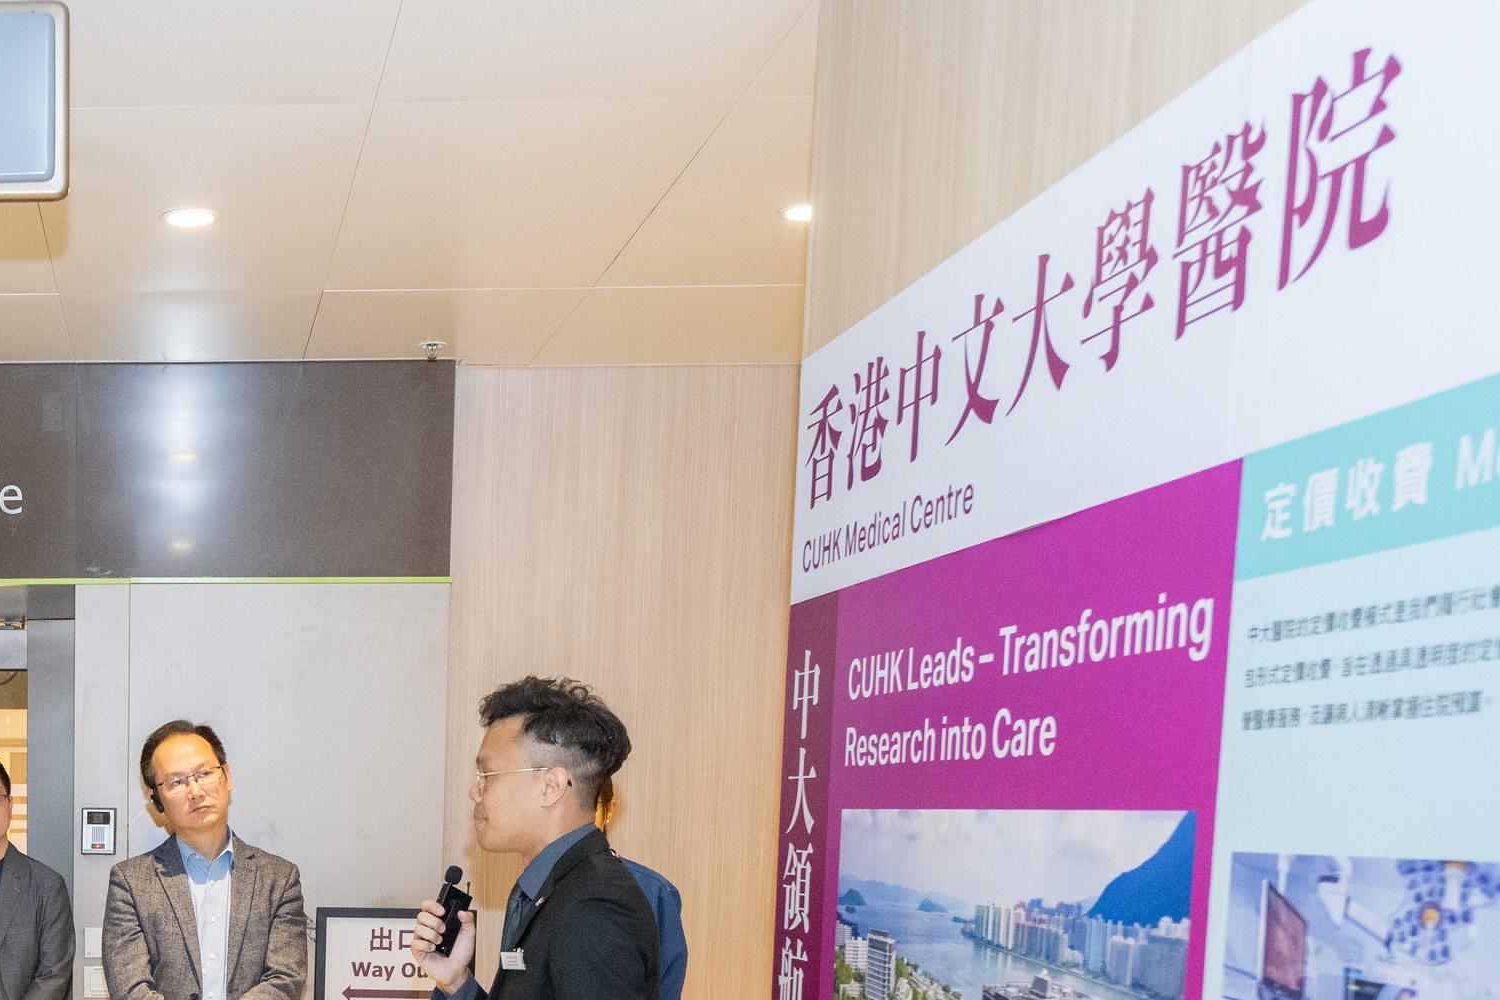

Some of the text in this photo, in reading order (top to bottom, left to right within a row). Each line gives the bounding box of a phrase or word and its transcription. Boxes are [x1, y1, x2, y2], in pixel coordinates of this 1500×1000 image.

[804, 47, 1402, 510] 香港中文大學醫院
[802, 481, 974, 573] CUHK Medical Centre
[1260, 441, 1434, 543] 定價收費
[848, 649, 905, 700] CUHK
[907, 637, 975, 691] Leads
[999, 593, 1215, 677] Transforming
[845, 708, 1057, 767] Research into Care
[352, 961, 428, 981] Way Ou
